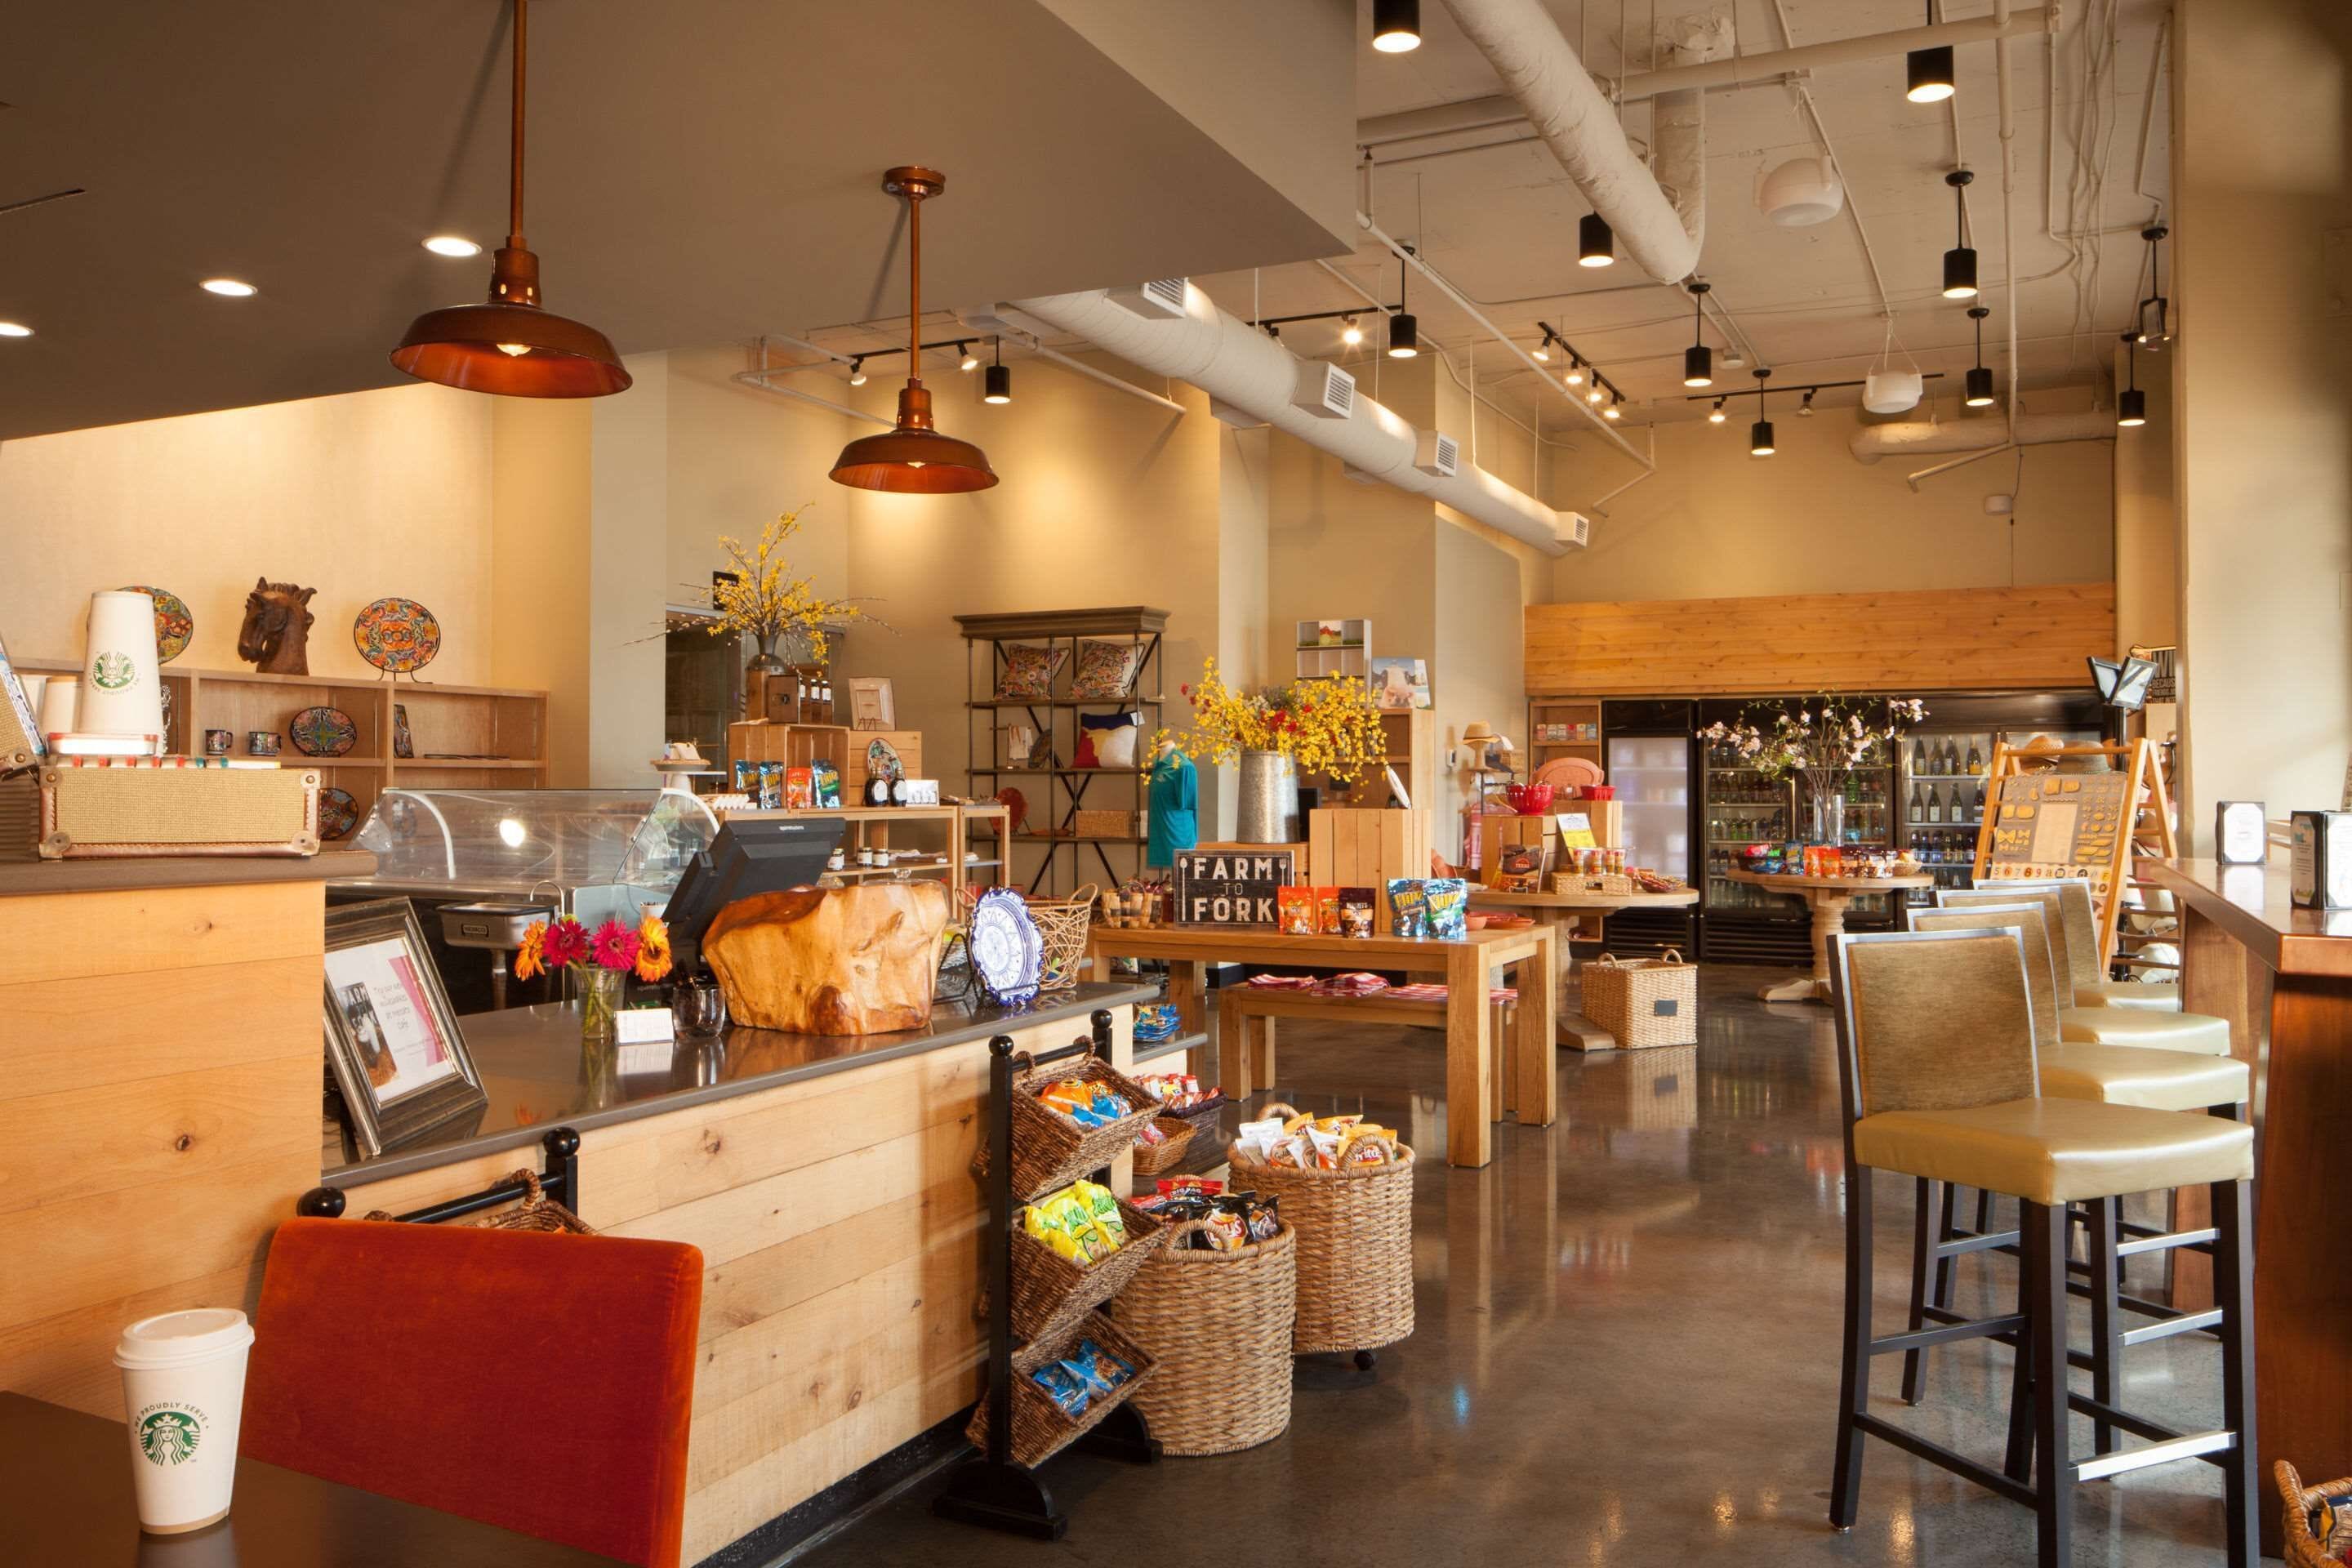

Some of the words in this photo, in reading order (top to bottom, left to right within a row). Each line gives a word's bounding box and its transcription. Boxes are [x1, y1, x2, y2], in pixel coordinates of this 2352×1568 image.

[1194, 858, 1272, 880] FARM
[1223, 883, 1243, 895] TO
[1194, 898, 1274, 922] FORK
[135, 1415, 141, 1428] WE
[140, 1401, 180, 1416] PROUDLY
[184, 1404, 208, 1422] SERVE
